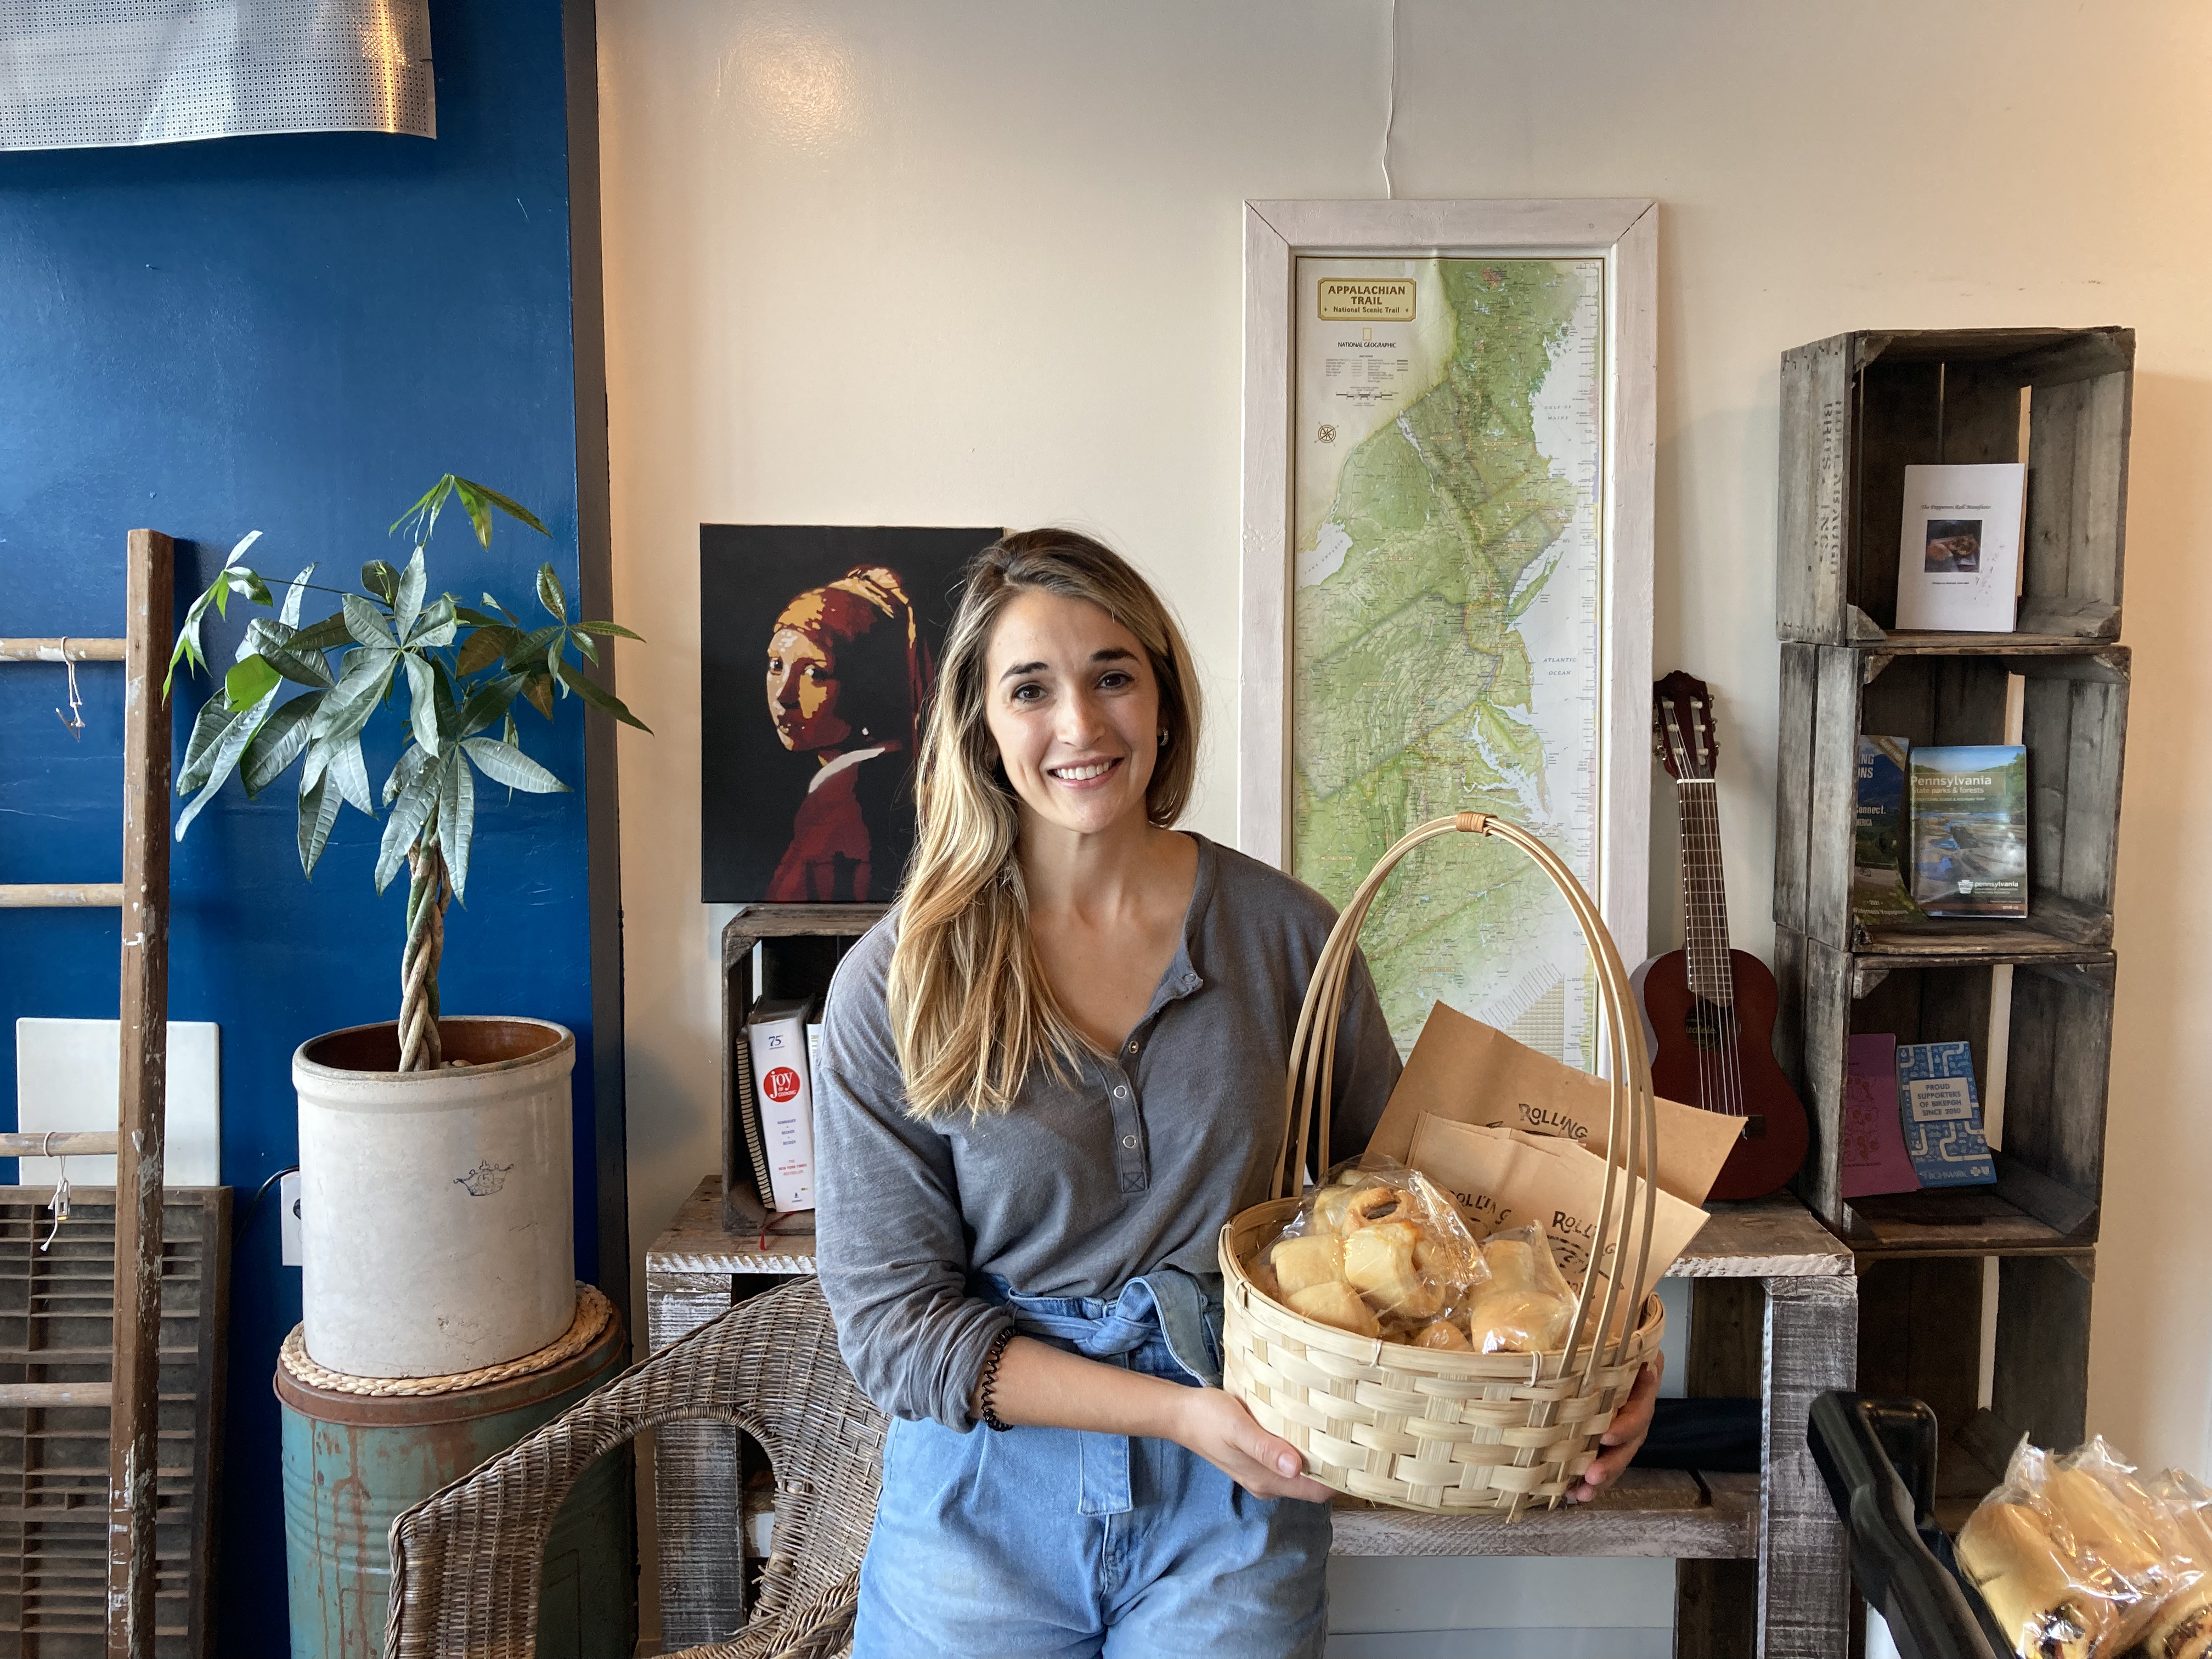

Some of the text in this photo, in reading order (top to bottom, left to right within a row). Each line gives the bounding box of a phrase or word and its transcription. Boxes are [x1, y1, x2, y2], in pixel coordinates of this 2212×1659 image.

[1328, 285, 1406, 295] APPALACHIAN
[1351, 296, 1383, 305] TRAIL
[1910, 775, 1991, 787] Pennsylvania
[1857, 805, 1886, 814] onnect.
[1917, 1091, 1961, 1099] SUPPORTERS
[1518, 1103, 1589, 1140] ROLLING
